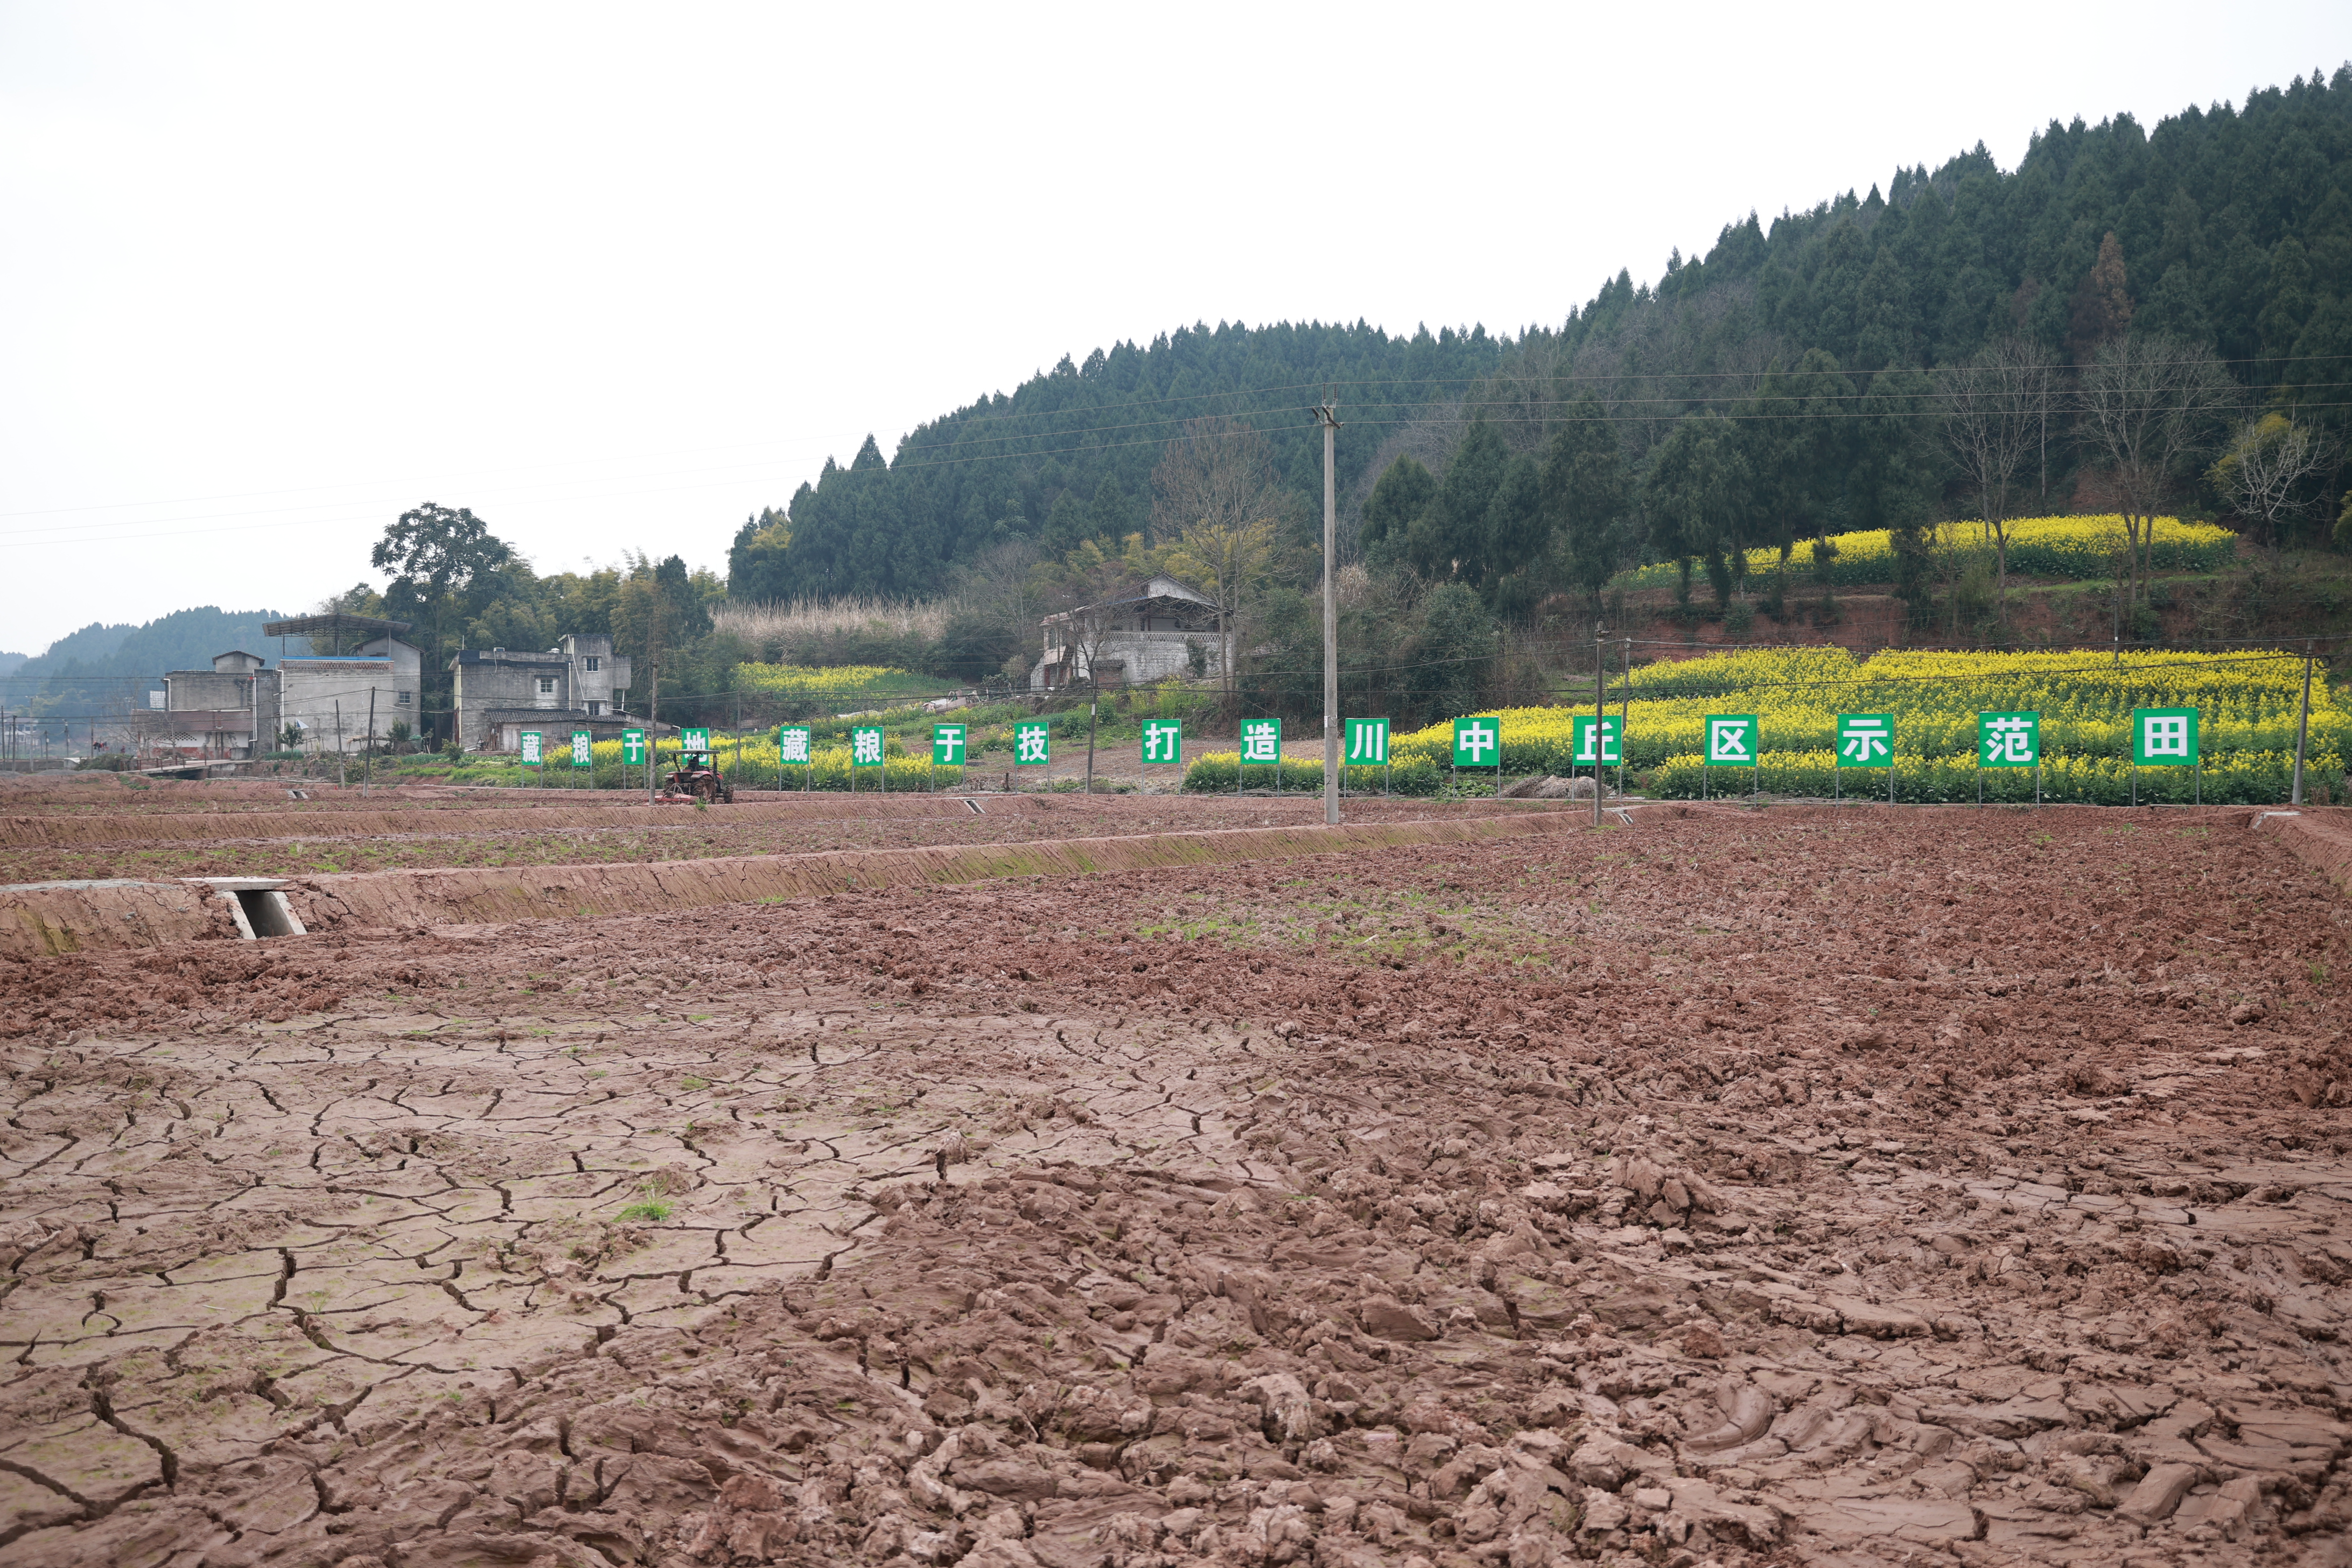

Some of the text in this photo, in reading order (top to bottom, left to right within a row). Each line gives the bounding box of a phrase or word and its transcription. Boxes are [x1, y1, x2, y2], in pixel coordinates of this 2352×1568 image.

[523, 734, 540, 763] 藏
[573, 733, 589, 763] 粮
[625, 733, 643, 762] 于
[782, 726, 1047, 763] 藏 粮 于 技
[1145, 716, 2187, 762] 打 造 川 中 丘 区 示 范 田
